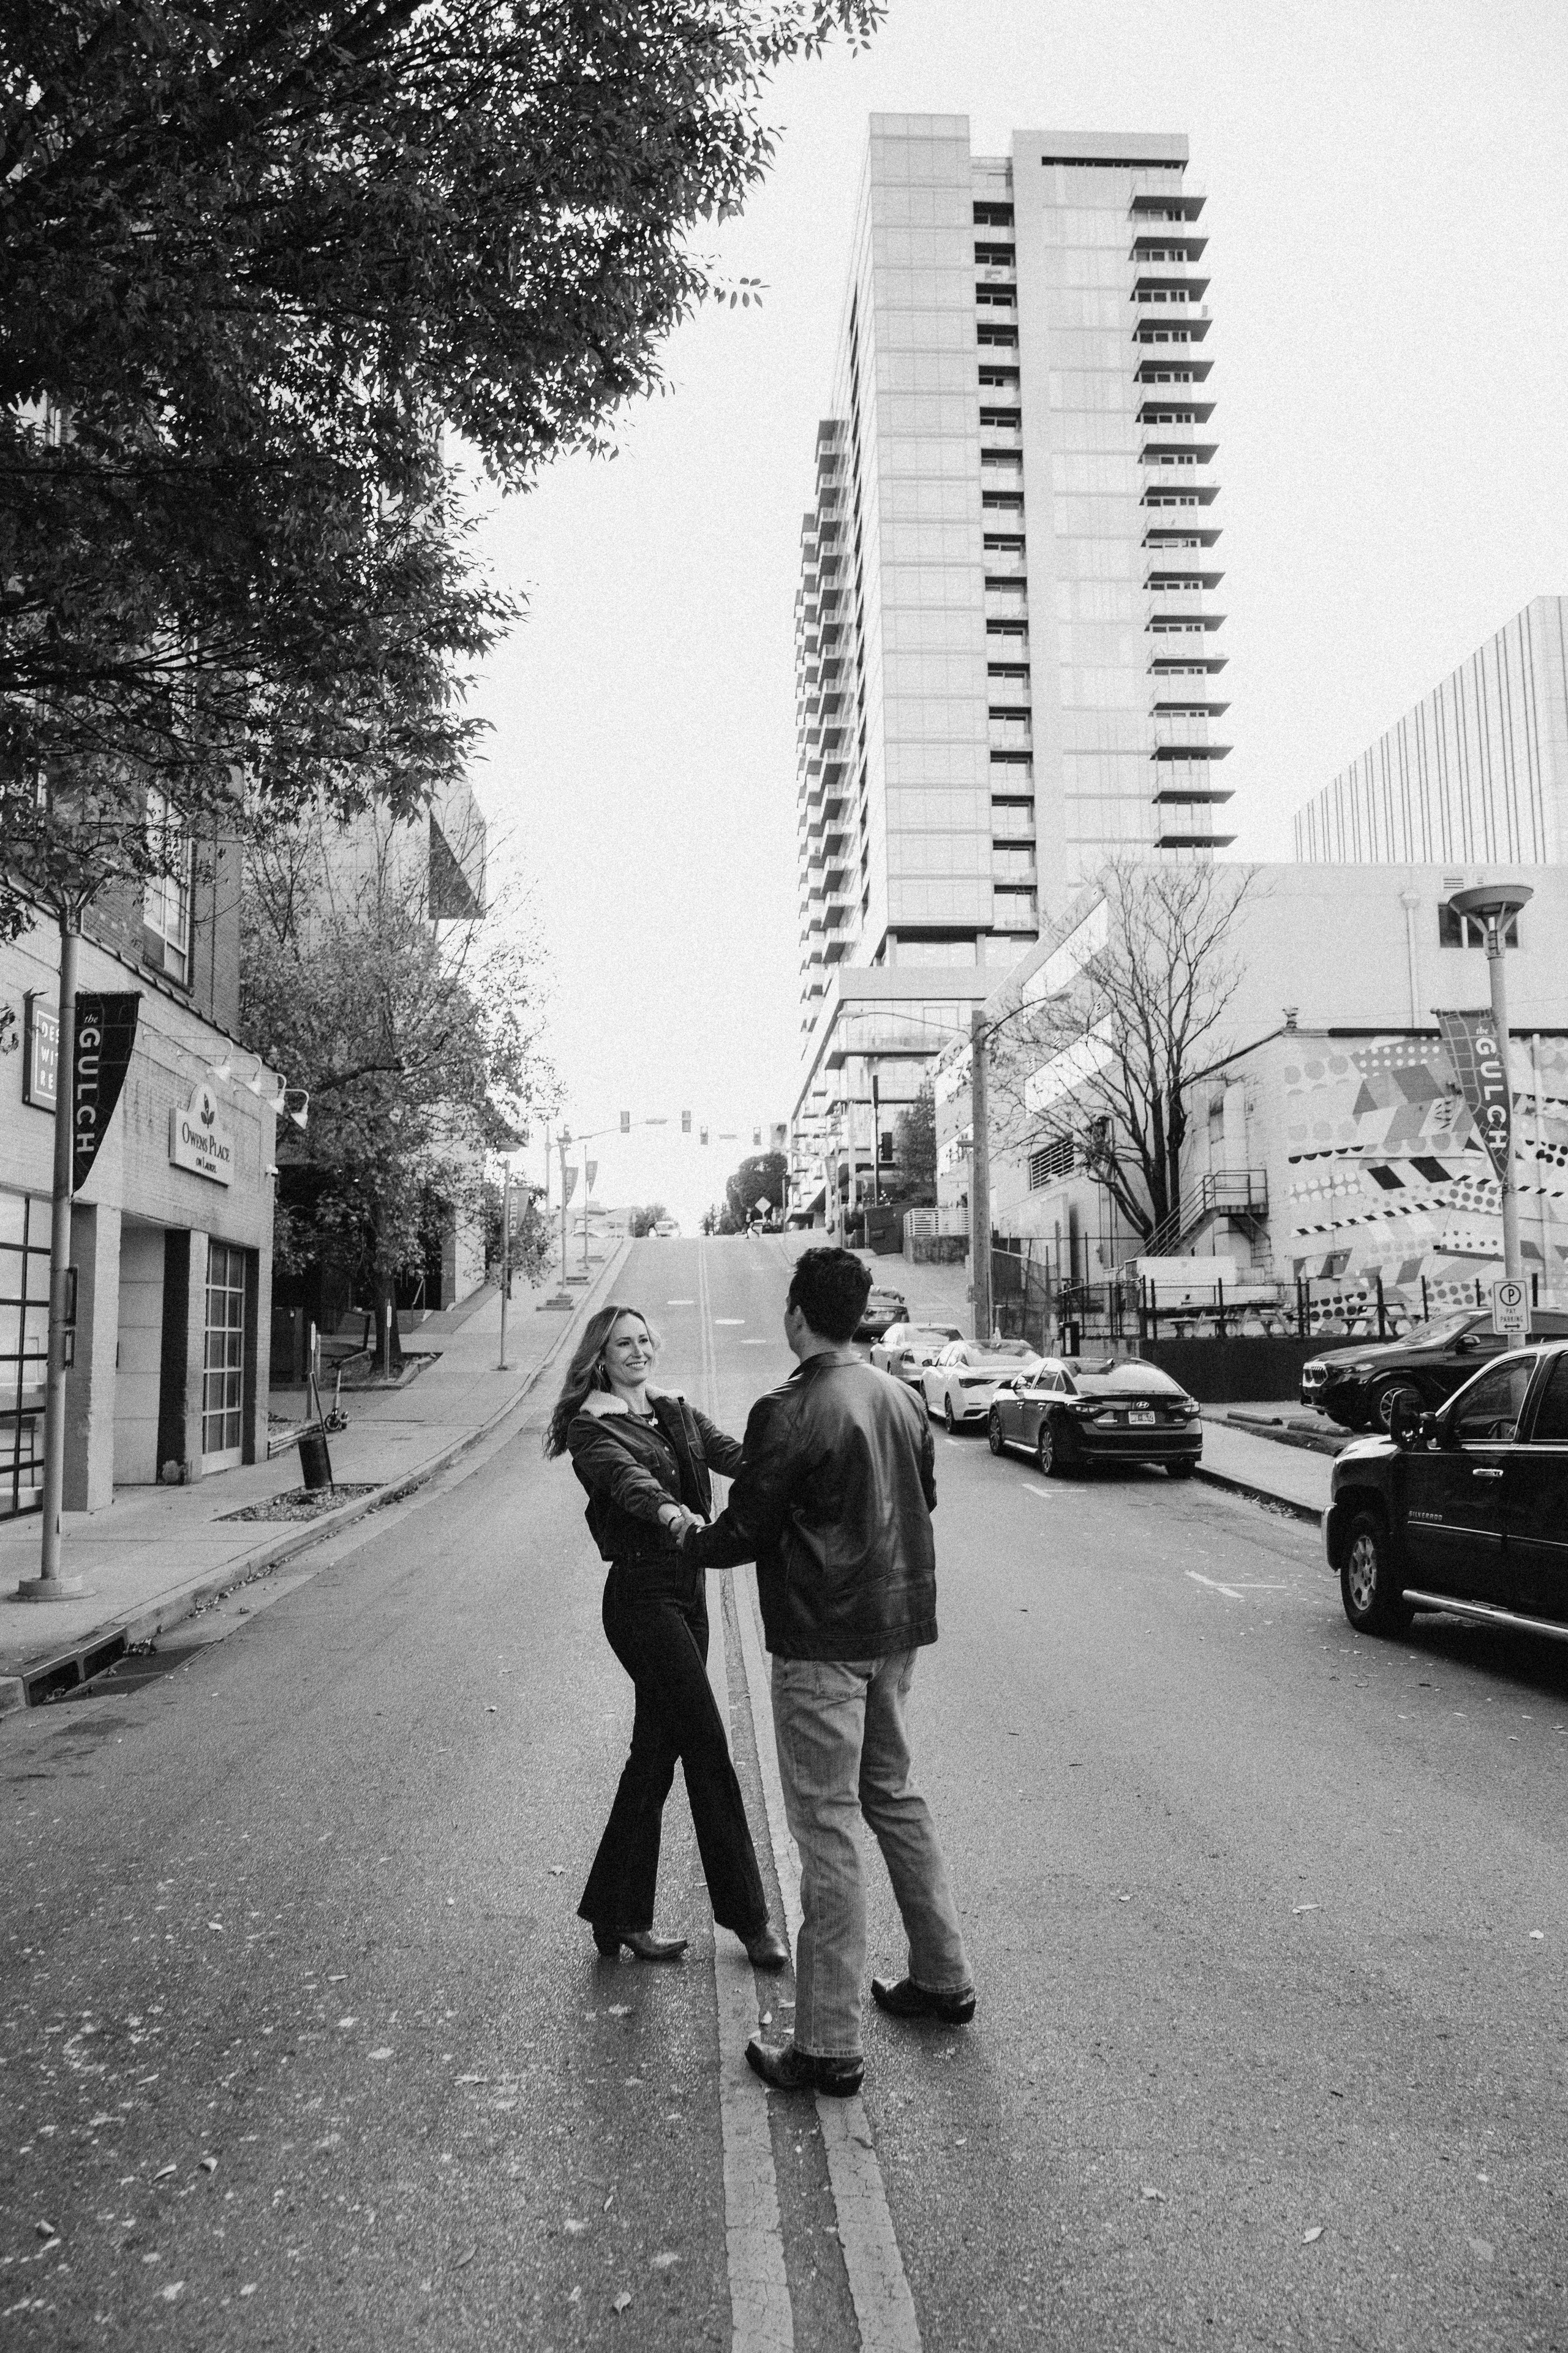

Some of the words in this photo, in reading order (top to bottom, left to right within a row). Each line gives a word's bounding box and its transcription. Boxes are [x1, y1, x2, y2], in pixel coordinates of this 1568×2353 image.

[84, 1014, 98, 1024] the
[1476, 1026, 1488, 1035] the
[77, 1027, 100, 1152] GULCH
[1476, 1037, 1507, 1148] GULCH
[509, 1197, 518, 1236] GULCH
[1509, 1289, 1514, 1302] P
[1409, 1511, 1442, 1520] SILVERADO
